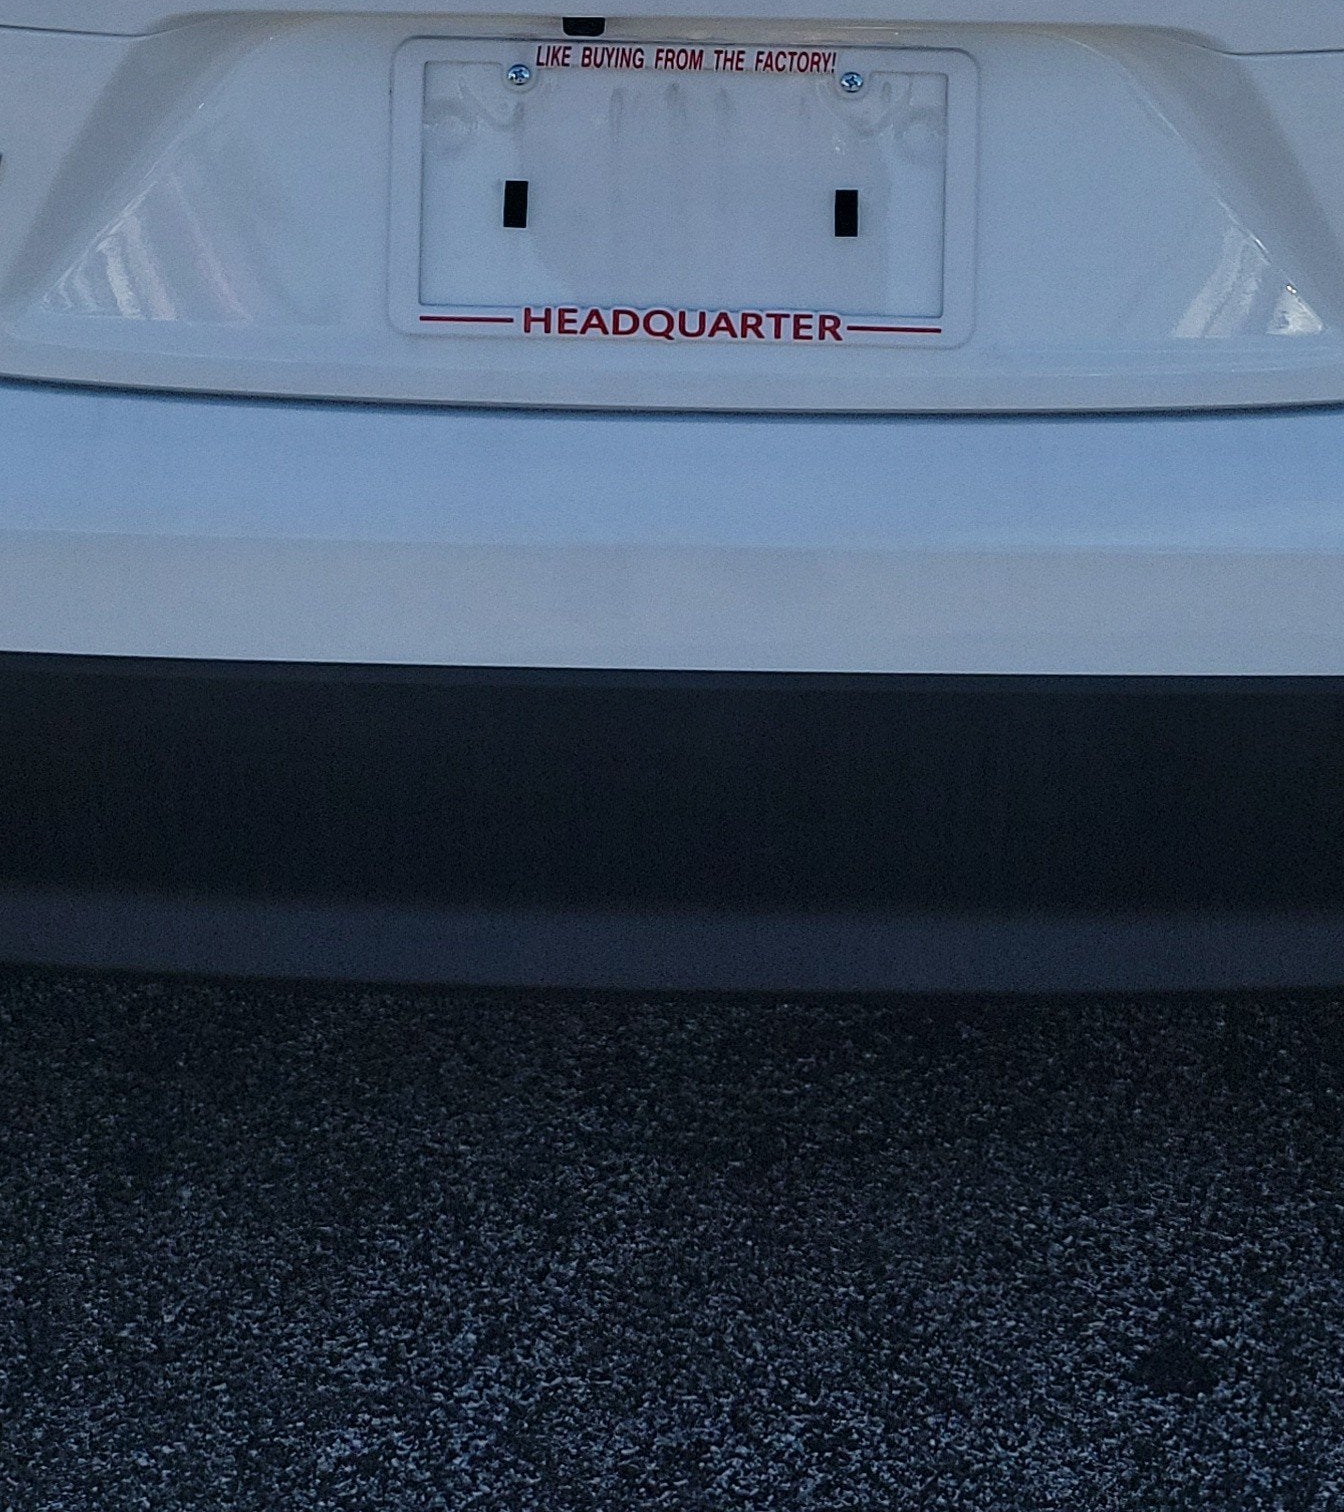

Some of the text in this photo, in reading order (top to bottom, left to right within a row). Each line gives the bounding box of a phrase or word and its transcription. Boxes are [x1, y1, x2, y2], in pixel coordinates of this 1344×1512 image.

[535, 45, 837, 74] LIKE BUYING FROM THE FACTORY!
[523, 307, 843, 342] HEADQUARTER
